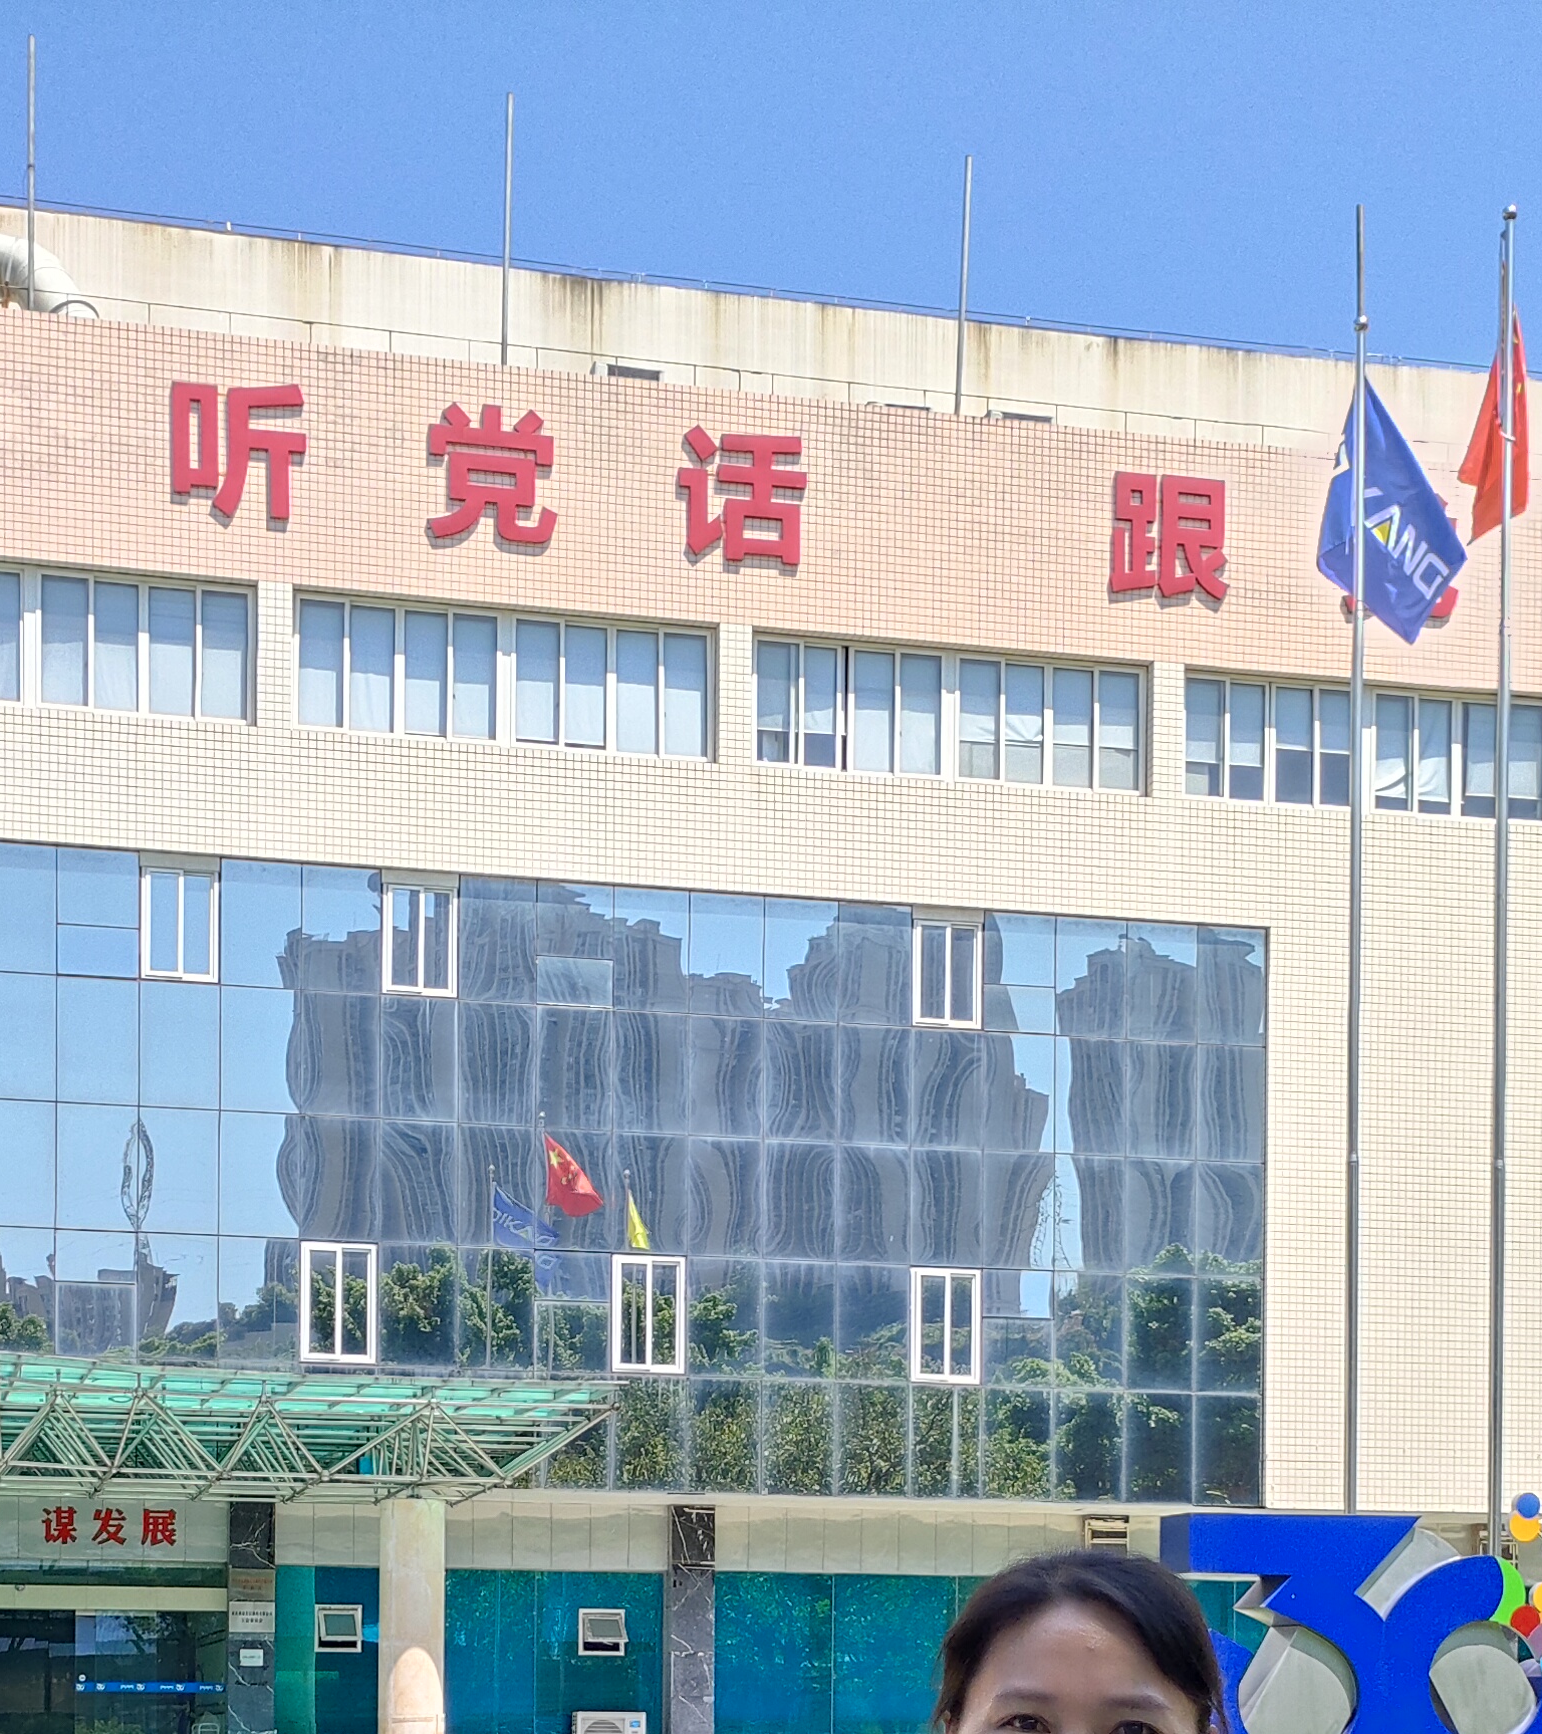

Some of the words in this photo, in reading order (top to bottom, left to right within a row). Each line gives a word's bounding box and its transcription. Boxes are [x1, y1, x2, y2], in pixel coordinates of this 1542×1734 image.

[171, 380, 808, 565] 听党话
[41, 1506, 178, 1547] 谋发展
